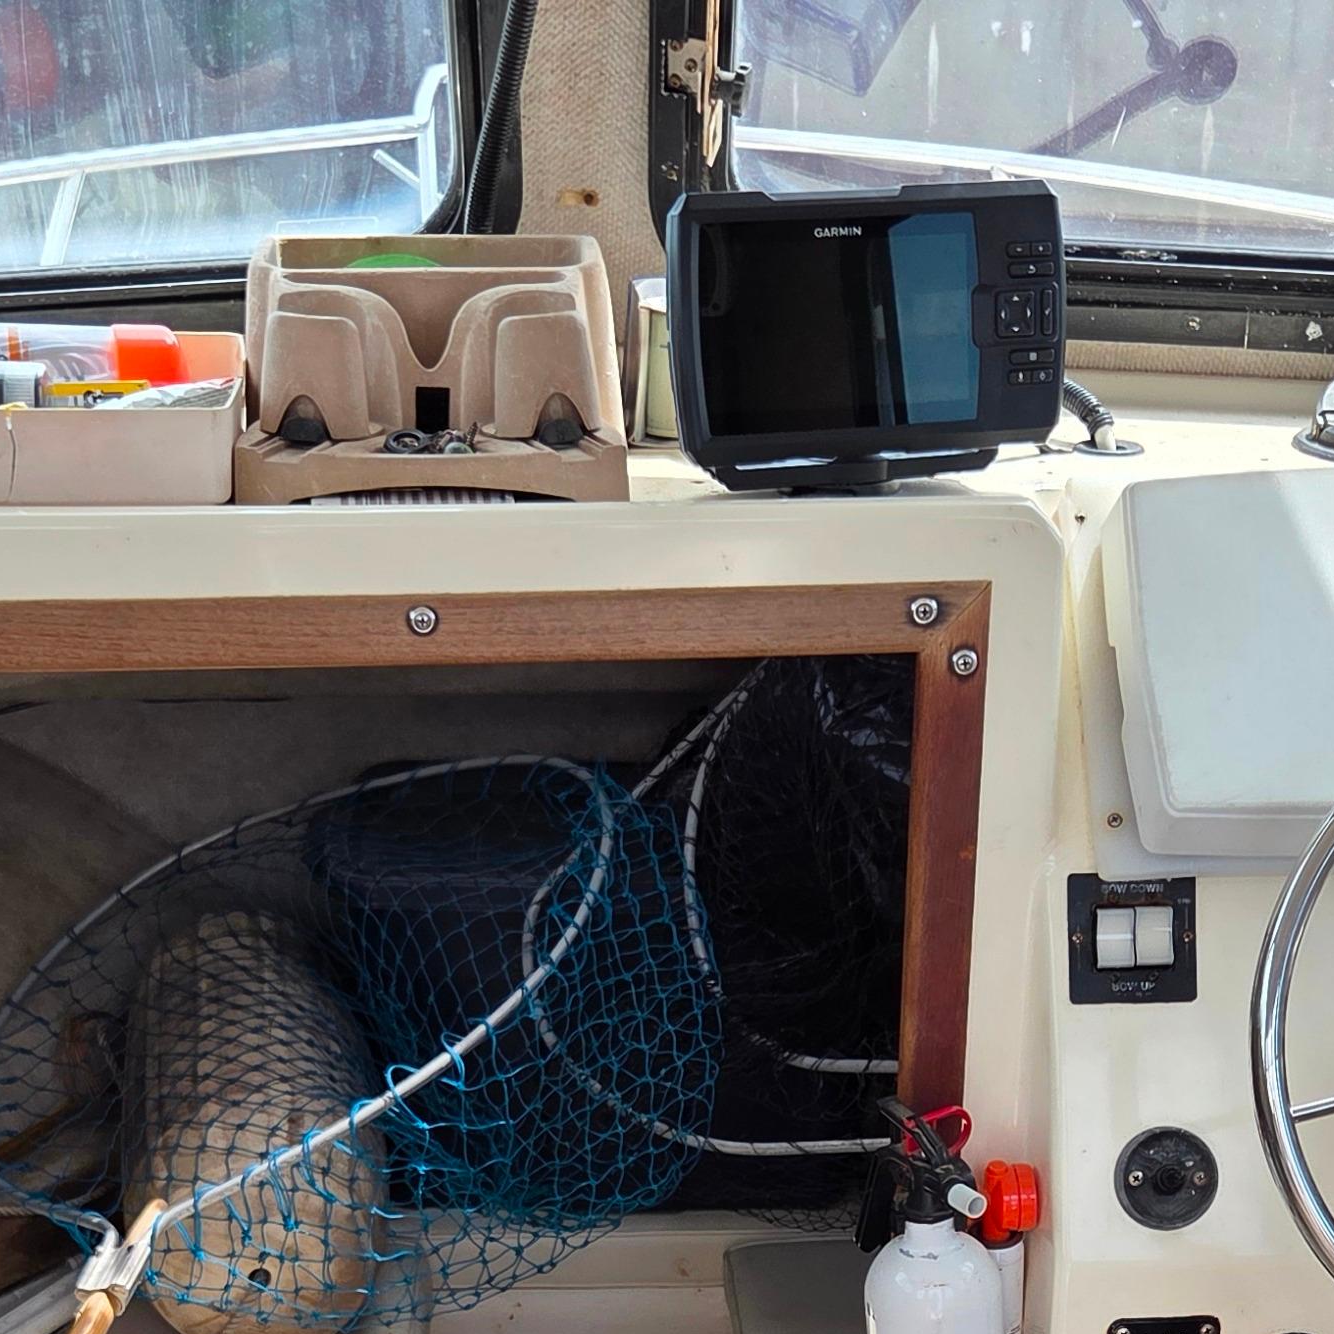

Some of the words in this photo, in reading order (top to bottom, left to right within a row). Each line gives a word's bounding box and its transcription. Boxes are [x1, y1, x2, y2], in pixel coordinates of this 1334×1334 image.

[814, 226, 862, 238] GARMIN
[1100, 883, 1127, 894] BOW
[1130, 883, 1164, 893] DOWN
[1140, 981, 1156, 992] UP
